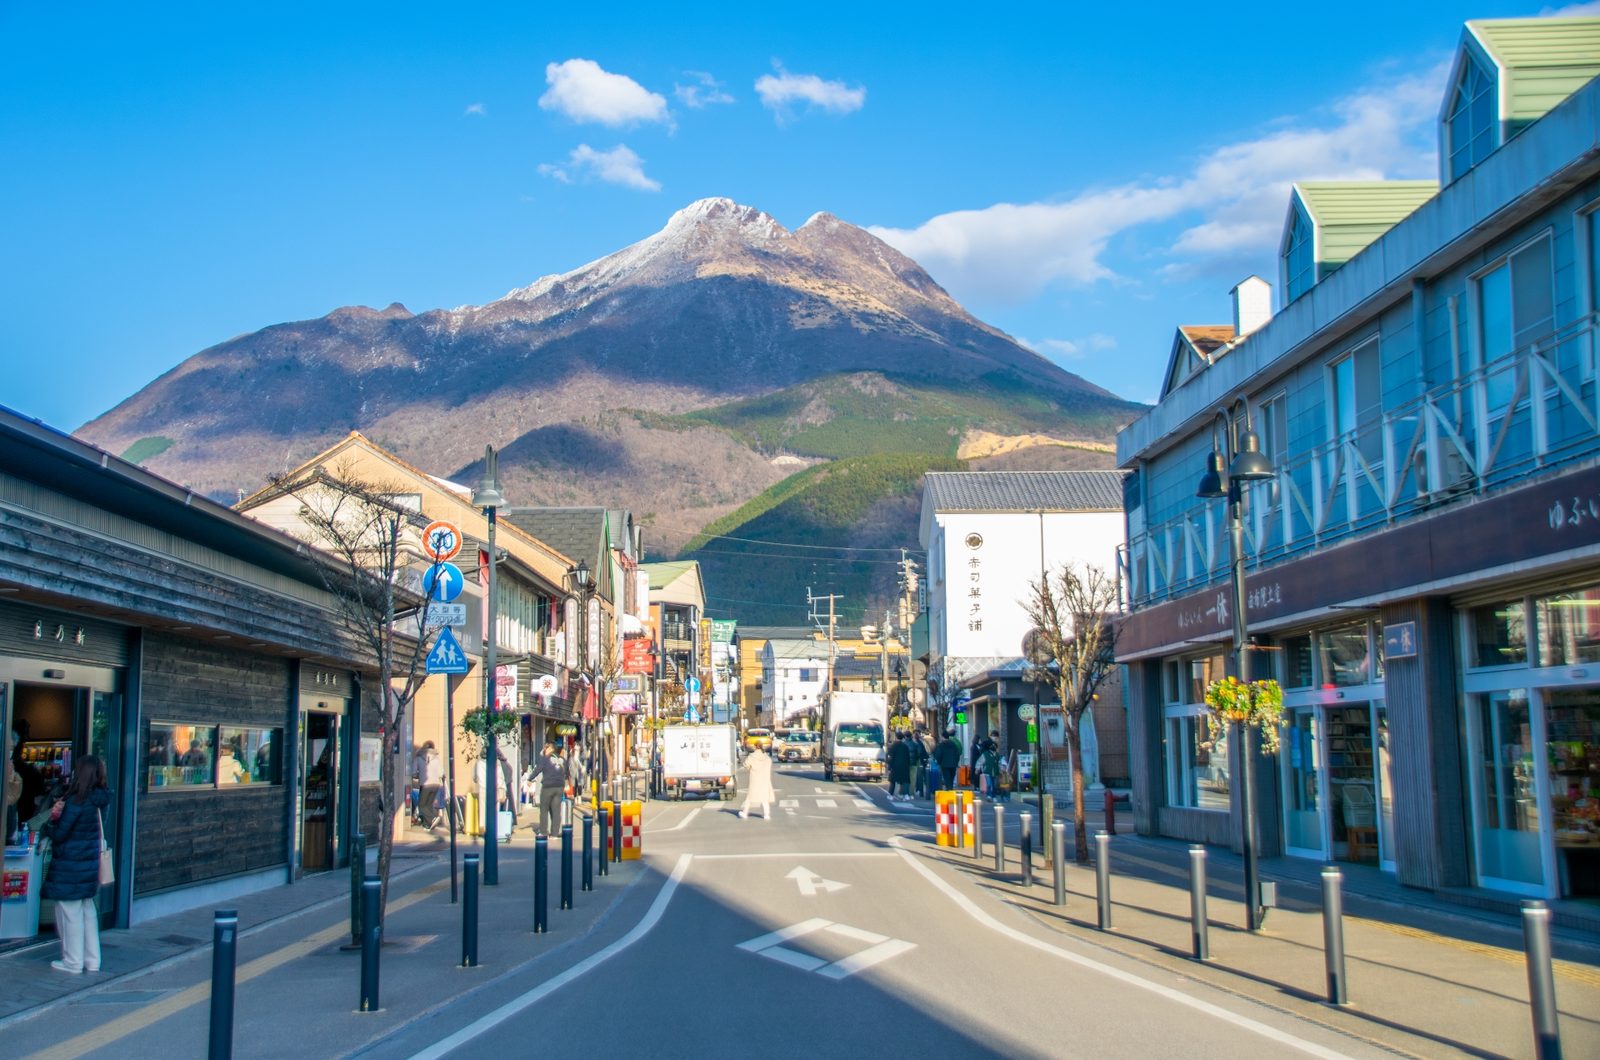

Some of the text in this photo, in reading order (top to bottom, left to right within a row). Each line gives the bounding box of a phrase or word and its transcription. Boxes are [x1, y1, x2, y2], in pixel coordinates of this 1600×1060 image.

[967, 556, 983, 632] 赤司菓子舗
[1205, 591, 1229, 625] 一休
[1387, 627, 1412, 652] 一休
